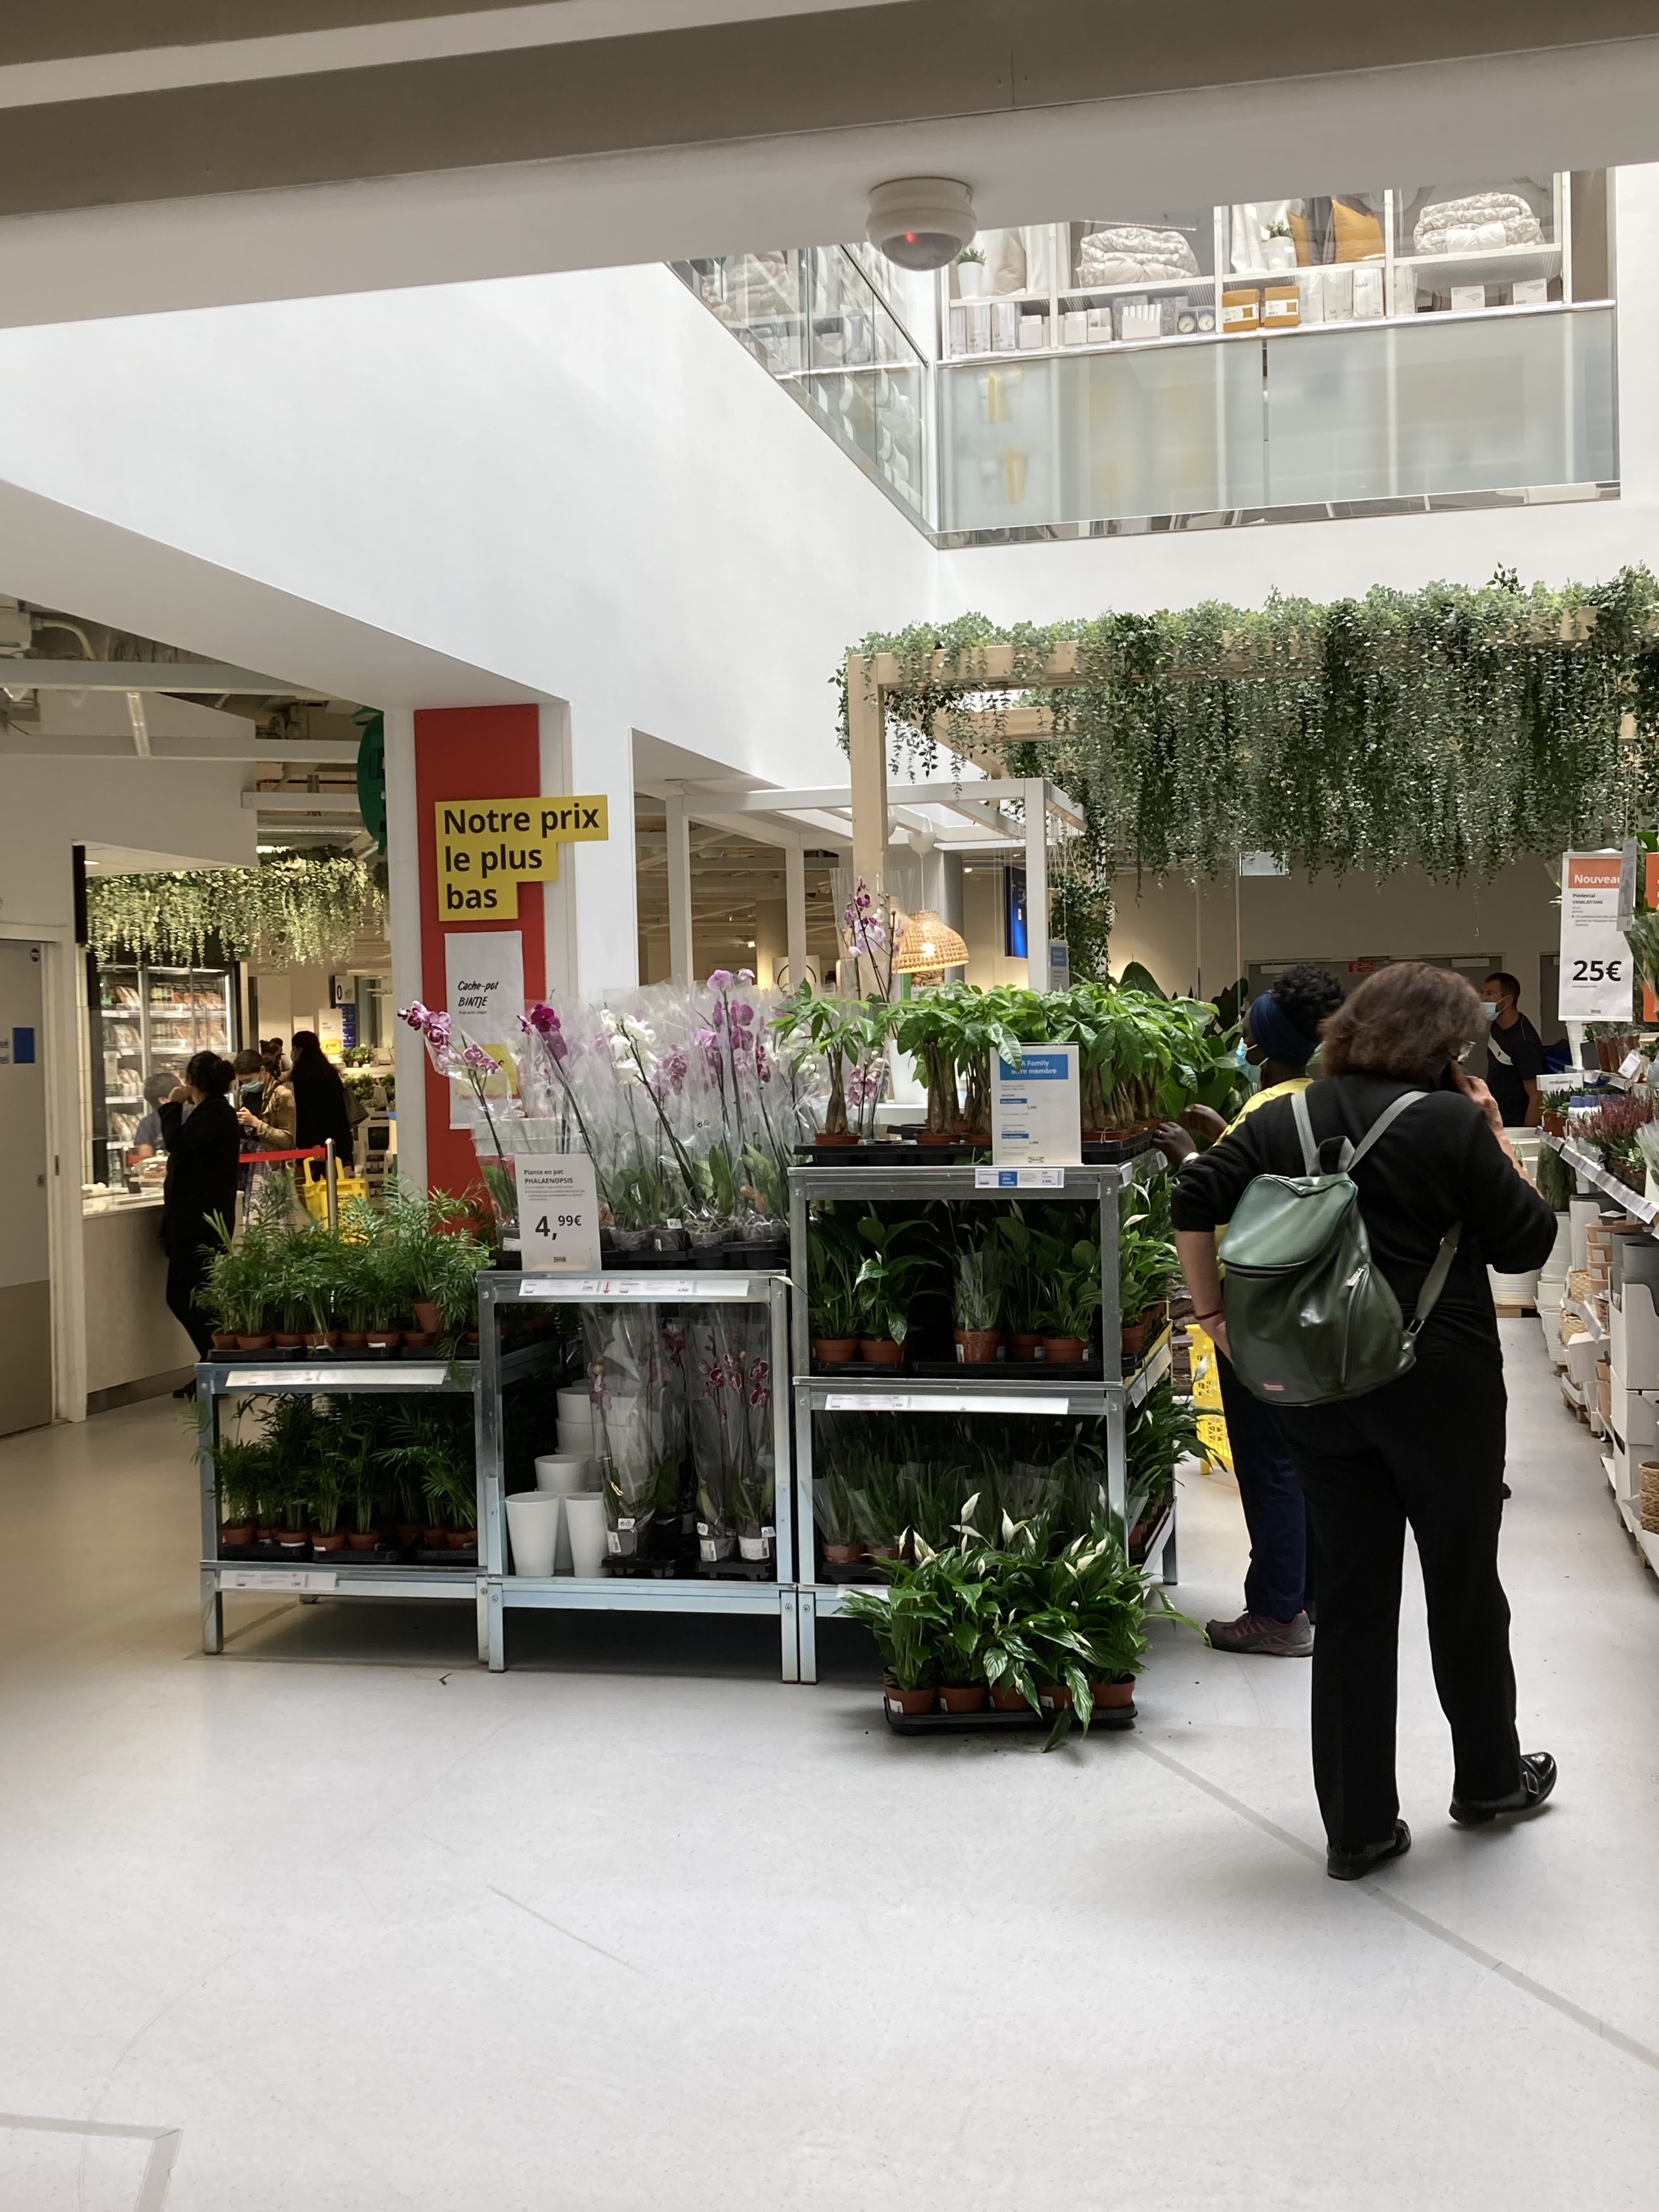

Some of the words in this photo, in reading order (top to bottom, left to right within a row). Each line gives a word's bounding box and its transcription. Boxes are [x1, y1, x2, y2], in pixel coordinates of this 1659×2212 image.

[444, 808, 531, 835] Notre
[541, 803, 600, 838] prix
[445, 846, 470, 873] le
[481, 844, 543, 878] plus
[446, 884, 498, 910] bas
[1572, 960, 1622, 981] 25€
[458, 980, 499, 992] Cache-pot
[458, 996, 488, 1009] BINTJE
